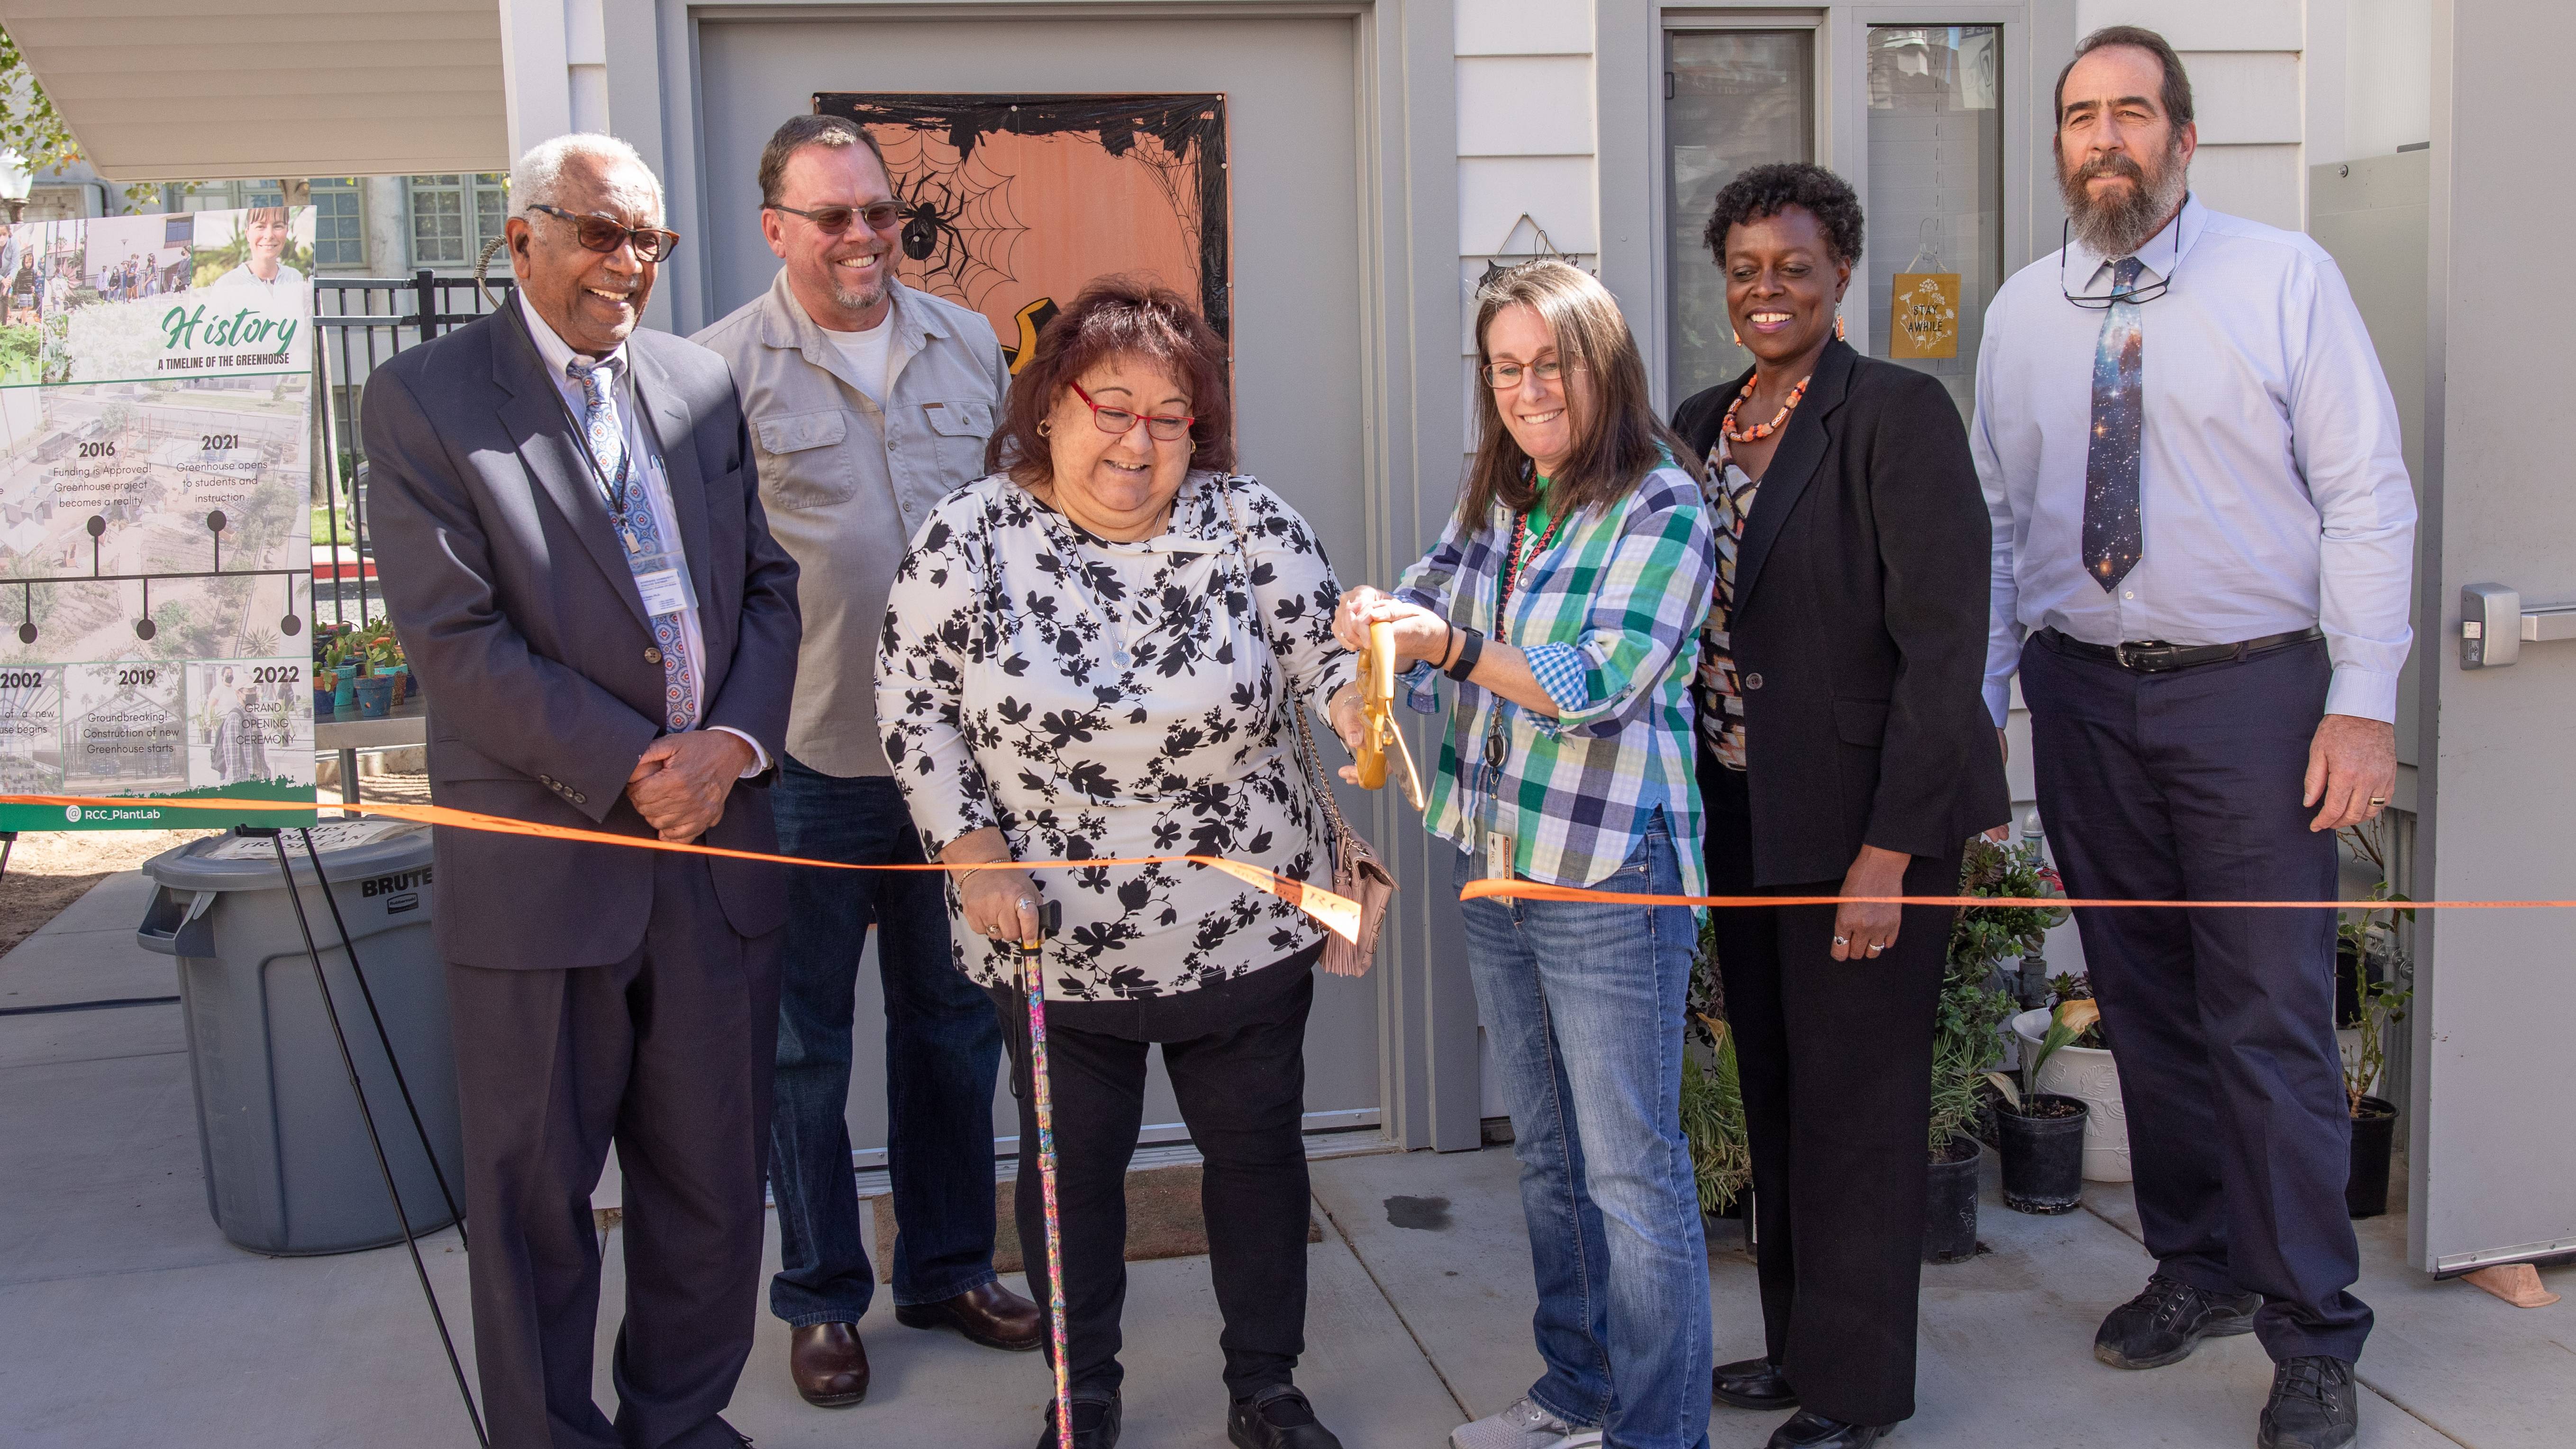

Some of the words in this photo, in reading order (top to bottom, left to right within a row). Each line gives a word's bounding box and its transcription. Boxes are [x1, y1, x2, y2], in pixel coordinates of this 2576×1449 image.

[1914, 305, 1938, 316] STAY
[162, 304, 298, 355] History
[1908, 321, 1942, 332] AWHILE
[158, 359, 164, 370] A
[166, 357, 203, 370] TIMELINE
[206, 356, 216, 367] OF
[218, 355, 234, 367] THE
[237, 353, 290, 366] GREENHOUSE
[202, 434, 238, 450] 2021
[79, 442, 116, 457] 2016
[54, 466, 90, 478] Funding
[102, 463, 152, 477] Approved!
[176, 461, 235, 472] Greenhouse
[238, 461, 268, 472] opens
[55, 481, 111, 492] Greenhouse
[114, 480, 148, 492] project
[182, 479, 192, 488] to
[195, 476, 236, 487] students
[239, 474, 258, 484] and
[59, 497, 101, 508] becomes
[114, 494, 143, 508] reality
[195, 493, 245, 503] instruction
[0, 672, 42, 688] 2002
[119, 669, 156, 685] 2019
[253, 666, 300, 683] 2022
[5, 708, 14, 718] of
[245, 702, 282, 712] GRAND
[88, 711, 168, 724] Groundbreaking!
[242, 718, 289, 729] OPENING
[17, 724, 47, 736] begins
[83, 729, 143, 738] Construction
[146, 727, 157, 737] of
[236, 734, 296, 745] CEREMONY
[87, 743, 145, 754] Greenhouse
[147, 744, 174, 753] starts
[85, 809, 161, 820] RCC_PlantLab
[362, 867, 432, 897] BRUTE
